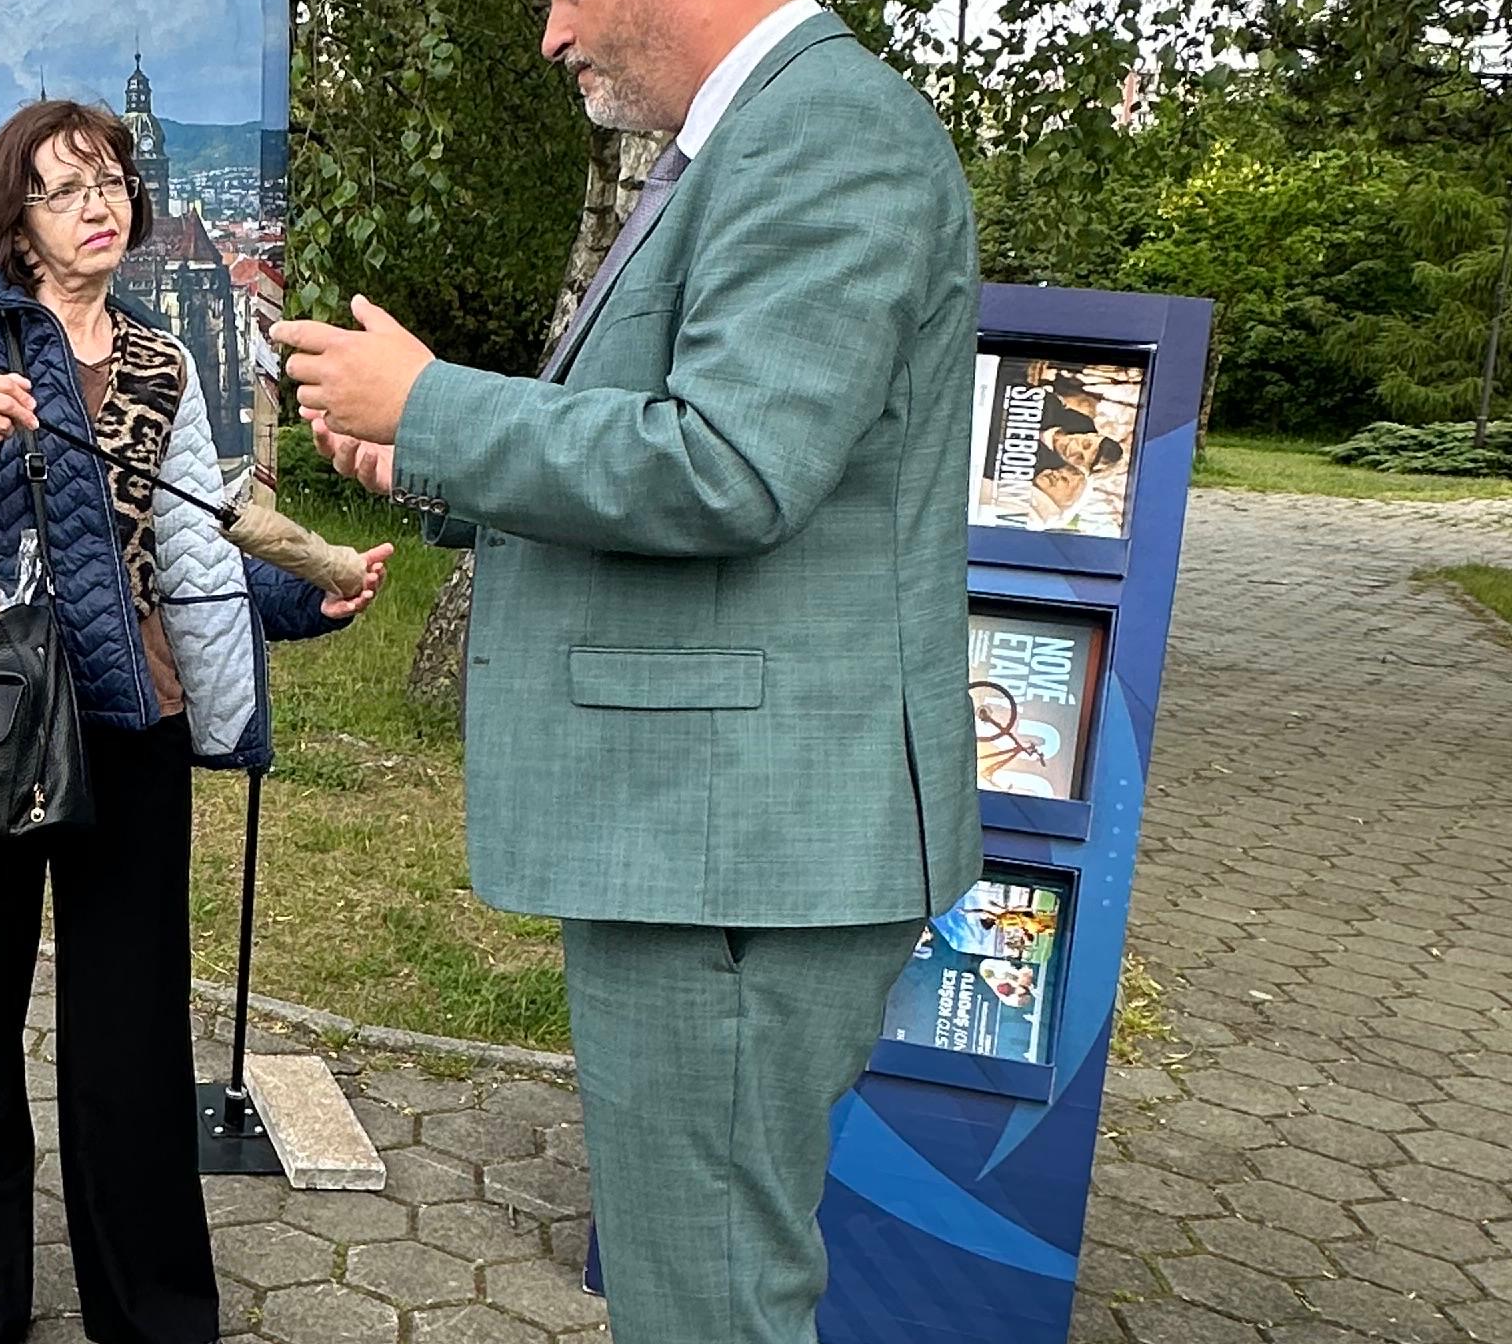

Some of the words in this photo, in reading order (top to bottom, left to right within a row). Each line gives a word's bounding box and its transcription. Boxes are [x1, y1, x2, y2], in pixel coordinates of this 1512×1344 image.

[1026, 636, 1076, 705] NOVÉ
[938, 968, 958, 1017] KOŠICE
[953, 972, 975, 1027] ŠPORTU
